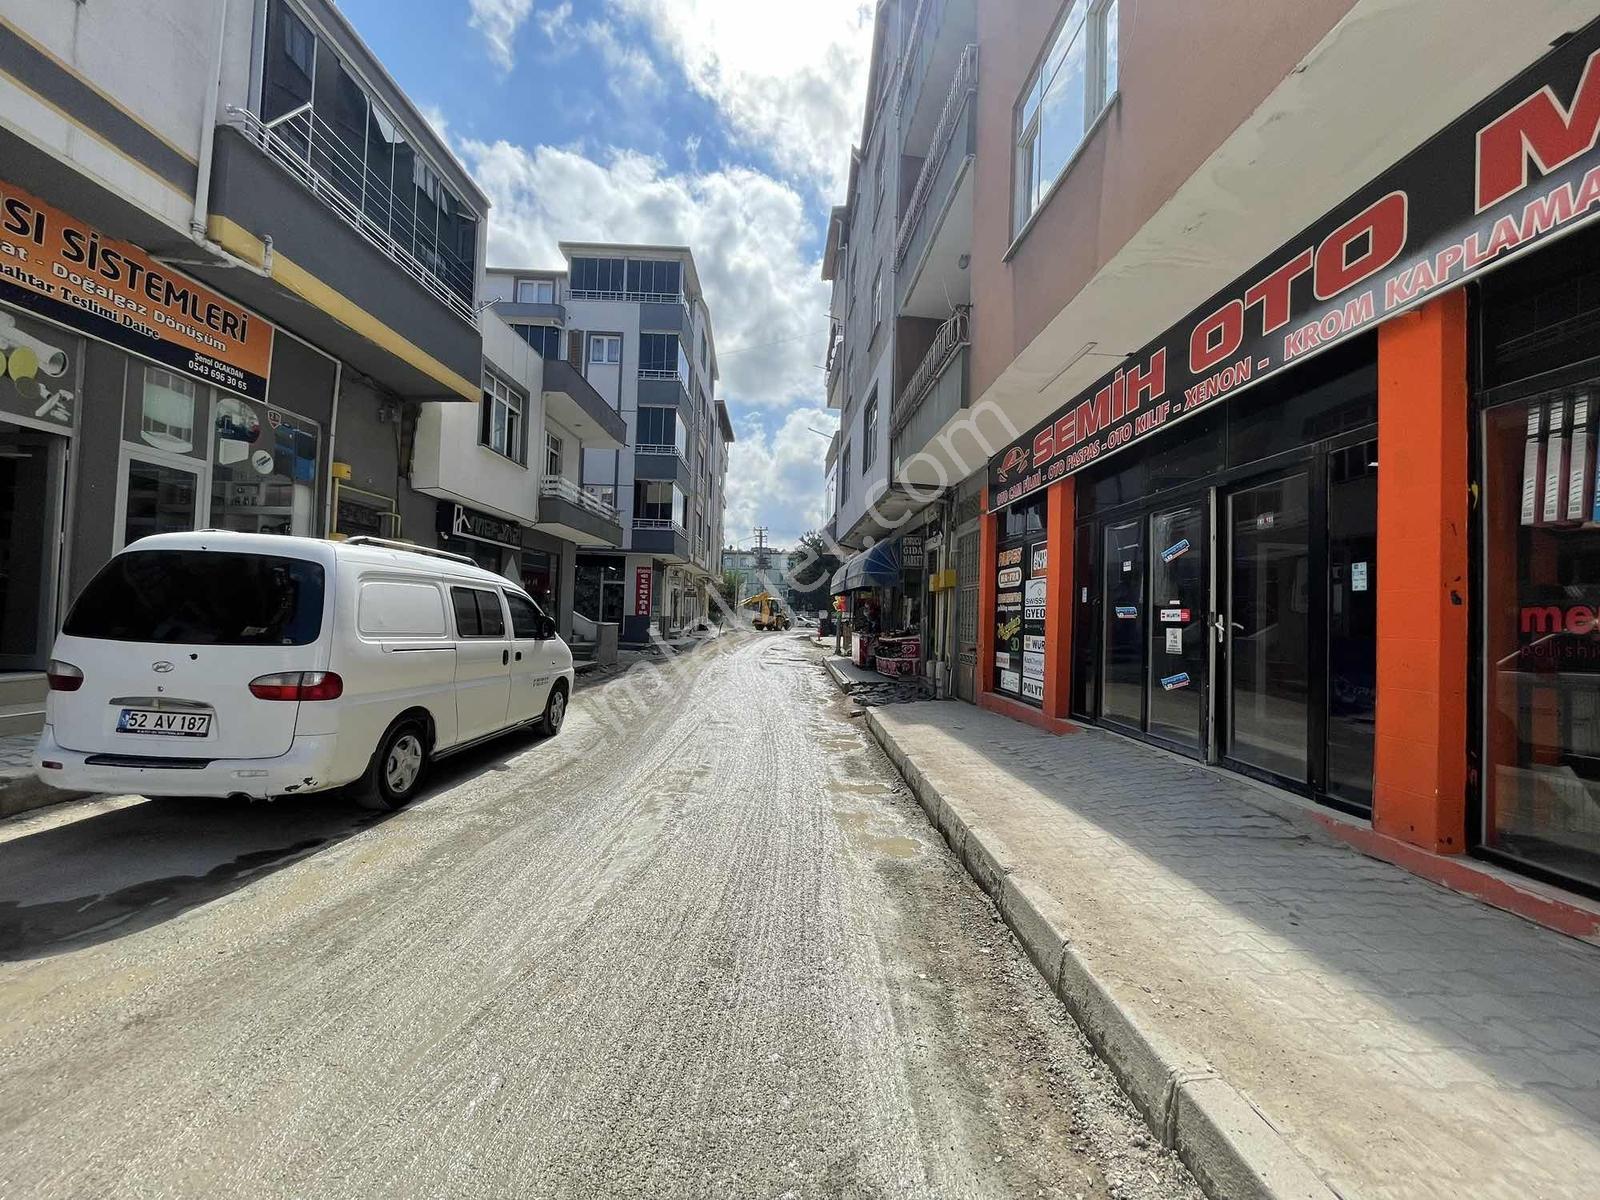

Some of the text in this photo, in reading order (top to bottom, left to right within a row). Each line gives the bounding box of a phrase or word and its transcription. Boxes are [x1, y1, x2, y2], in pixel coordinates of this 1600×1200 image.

[0, 190, 249, 345] SI SİSTEMLERİ
[52, 261, 148, 317] Doğalgaz
[153, 309, 227, 352] Dönüşüm
[61, 286, 119, 322] Teslimi
[121, 313, 160, 341] Daire
[1047, 461, 1065, 481] OTO
[1065, 439, 1100, 472] PASPAS
[1107, 421, 1133, 449] OTO
[1183, 356, 1252, 411] XENON
[1283, 290, 1375, 362] KROM
[1384, 164, 1600, 309] KAPLAMA
[1032, 346, 1167, 469] SEMİH
[1189, 189, 1408, 374] OTO
[188, 360, 208, 376] 0543
[903, 546, 923, 555] GIDA
[1521, 607, 1600, 634] me
[1023, 681, 1044, 697] POLYT
[129, 713, 148, 728] 52
[153, 714, 177, 729] AV
[180, 715, 207, 731] 187
